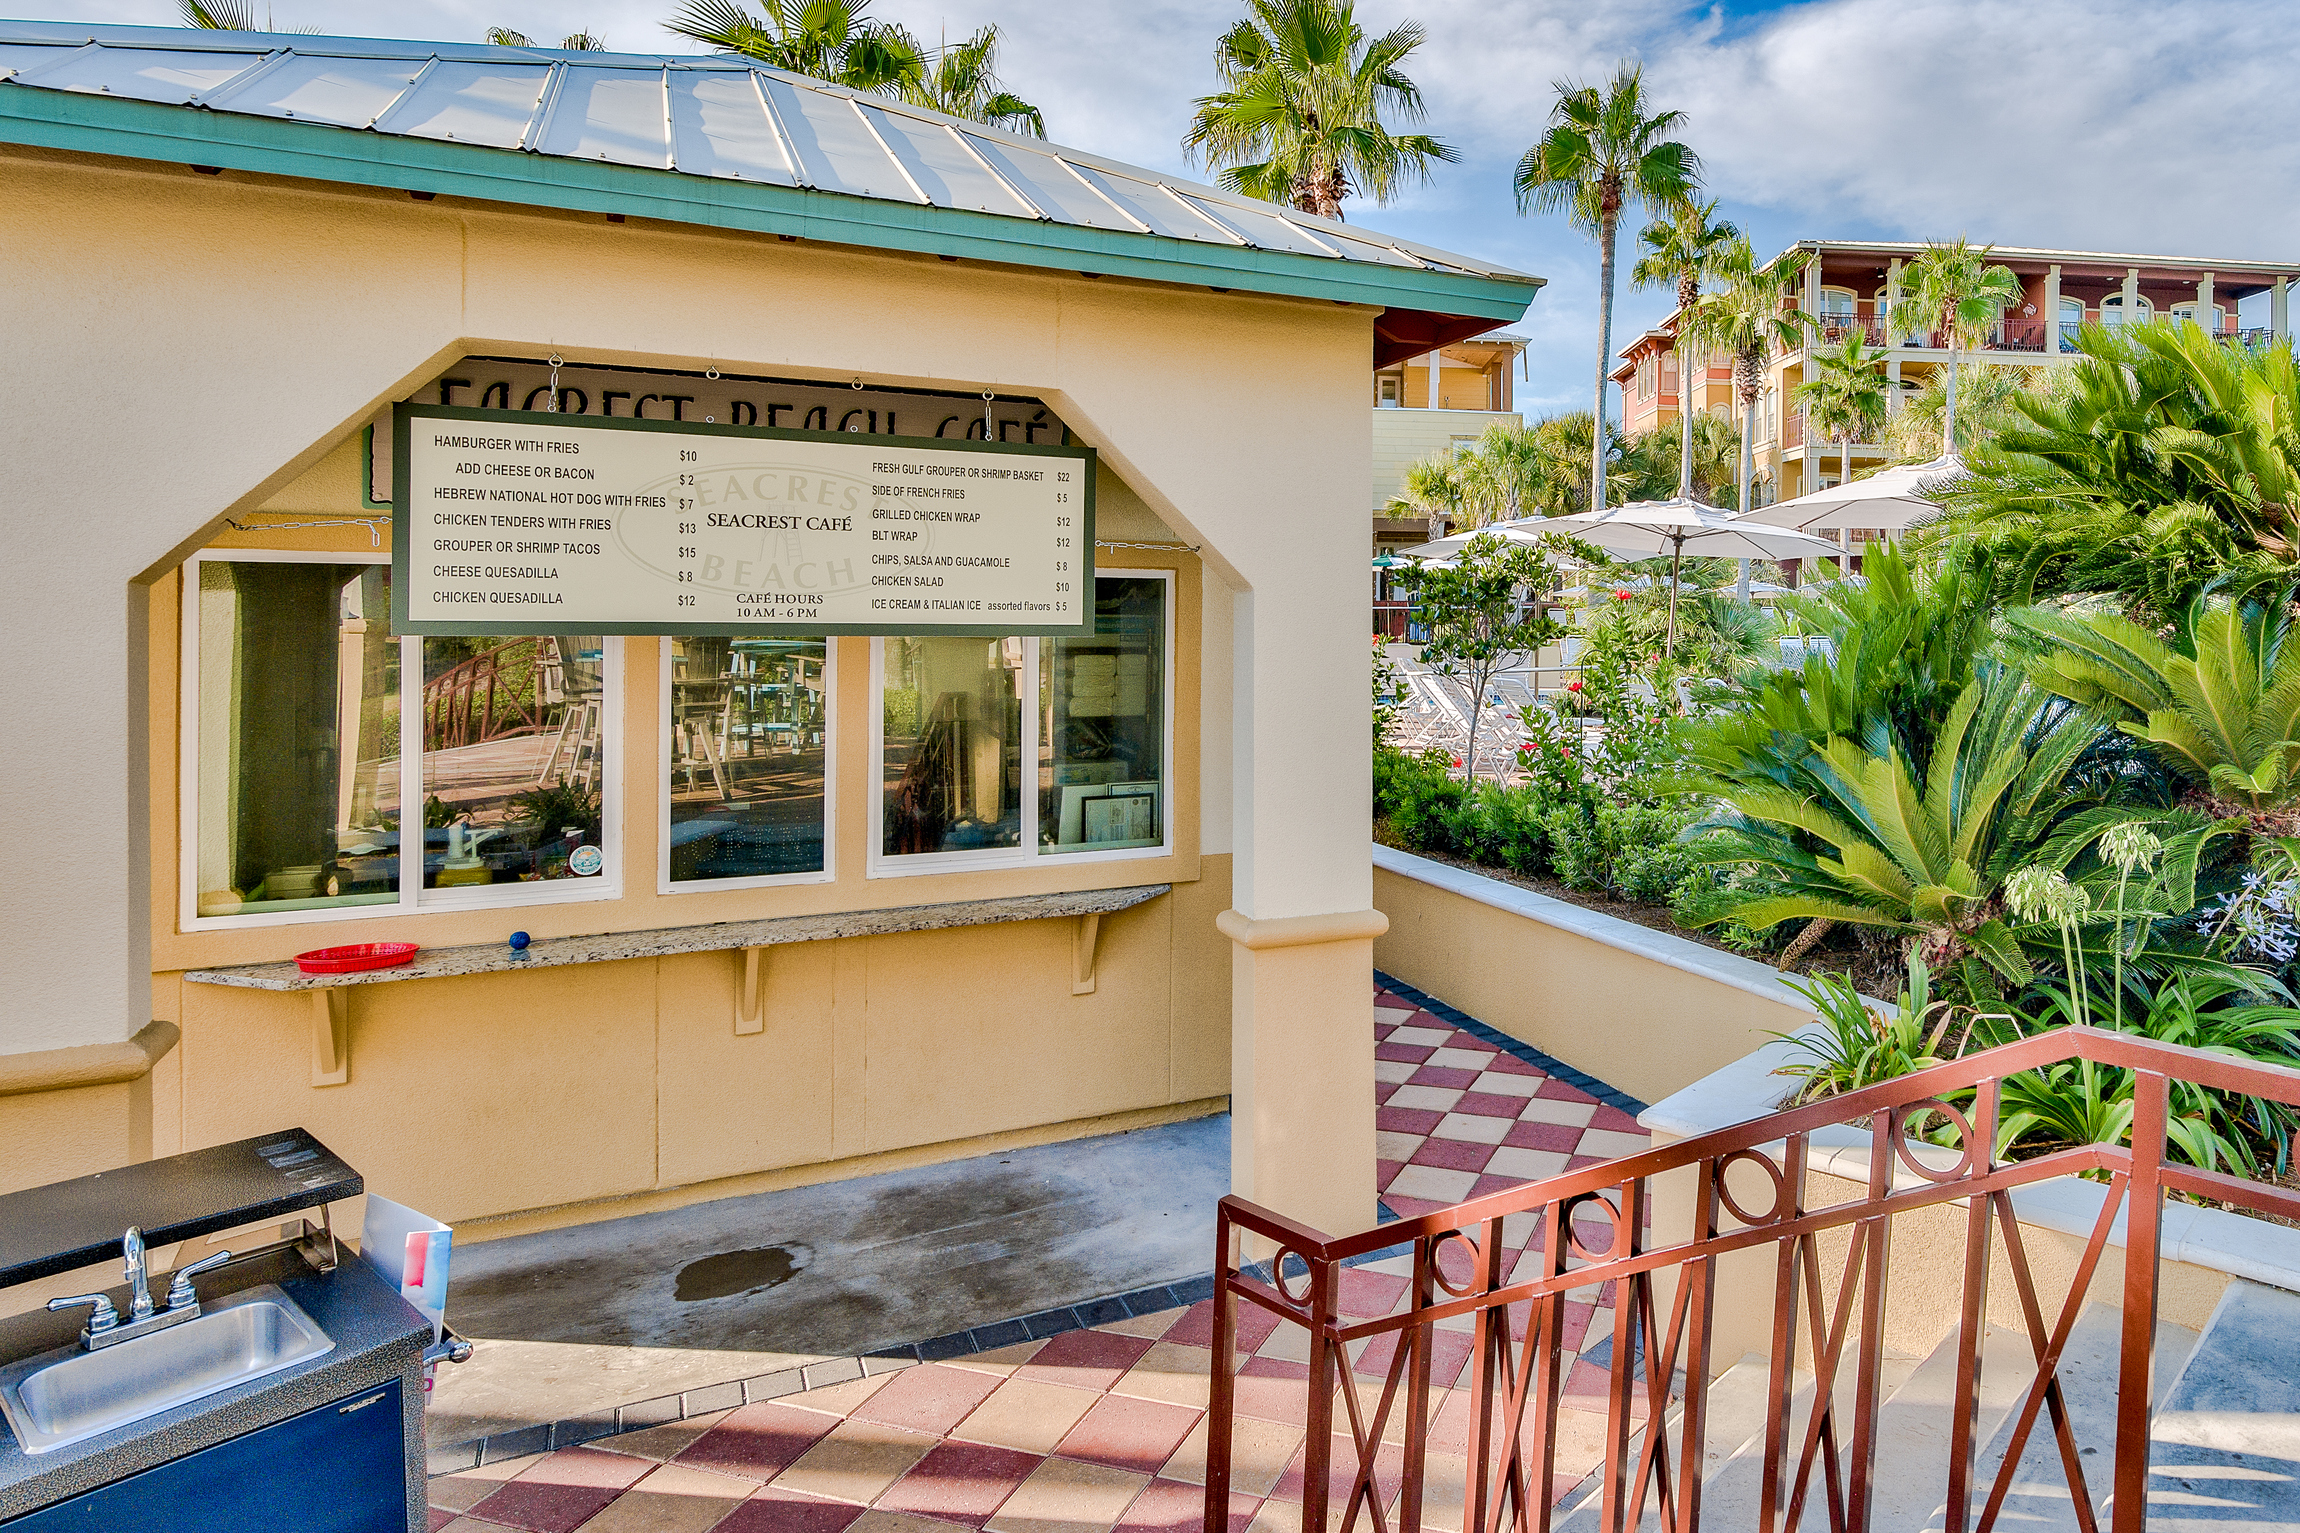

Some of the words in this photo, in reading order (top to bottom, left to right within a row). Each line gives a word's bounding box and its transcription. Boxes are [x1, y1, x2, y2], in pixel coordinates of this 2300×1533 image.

[434, 435, 512, 451] HAMBURGER
[514, 439, 544, 452] WITH
[547, 441, 580, 455] FRIES
[679, 449, 697, 462] $10
[455, 462, 481, 475] ADD
[484, 463, 531, 477] CHEESE
[534, 466, 551, 478] OR
[554, 467, 595, 480] BACON
[872, 462, 900, 474] FRESH
[902, 463, 924, 475] GULF
[926, 465, 966, 477] GROUPER
[967, 467, 980, 478] OR
[981, 468, 1012, 480] SHRIMP
[1013, 470, 1044, 482] BASKET
[1057, 471, 1070, 482] $22
[434, 487, 487, 501] HEBREW
[489, 489, 548, 503] NATIONAL
[550, 492, 574, 504] HOT
[576, 493, 602, 505] DOG
[604, 494, 632, 507] WITH
[635, 495, 666, 508] FRIES
[666, 472, 891, 520] SEACREST
[871, 484, 892, 496] SIDE
[893, 485, 905, 497] OF
[906, 486, 940, 498] FRENCH
[942, 488, 965, 500] FRIES
[433, 513, 487, 526] CHICKEN
[490, 515, 545, 528] TENDERS
[547, 517, 576, 529] WITH
[579, 518, 612, 531] FRIES
[706, 512, 802, 530] SEACREST
[805, 515, 853, 532] CAFÉ
[872, 508, 911, 521] GRILLED
[913, 510, 953, 522] CHICKEN
[954, 512, 981, 523] WRAP
[1056, 516, 1071, 527] $12
[678, 522, 697, 535] $13
[872, 530, 889, 541] BLT
[890, 530, 918, 542] WRAP
[1056, 537, 1070, 548] $12
[433, 539, 493, 552] GROUPER
[496, 541, 513, 553] OR
[516, 541, 560, 554] SHRIMP
[562, 542, 601, 555] TACOS
[678, 546, 696, 559] $15
[871, 553, 902, 569] CHIPS,
[903, 554, 934, 566] SALSA
[934, 556, 954, 567] AND
[955, 556, 1010, 568] GUACAMOLE
[433, 565, 482, 578] CHEESE
[484, 566, 559, 579] QUESADILLA
[699, 552, 857, 591] BEACH
[871, 575, 912, 587] CHICKEN
[913, 576, 944, 587] SALAD
[1056, 581, 1070, 592] $10
[433, 591, 486, 603] CHICKEN
[489, 591, 564, 604] QUESADILLA
[678, 594, 696, 607] $12
[736, 591, 772, 604] CAFÉ
[774, 594, 824, 605] HOURS
[871, 598, 887, 609] ICE
[888, 598, 921, 610] CREAM
[923, 599, 930, 610] &
[931, 599, 965, 610] ITALIAN
[967, 600, 981, 611] ICE
[987, 601, 1022, 611] assorted
[1024, 600, 1051, 611] flavors
[737, 608, 751, 617] 10
[754, 607, 775, 618] AM
[786, 608, 794, 618] 6
[797, 608, 817, 618] PM
[691, 826, 804, 862] OPEN
